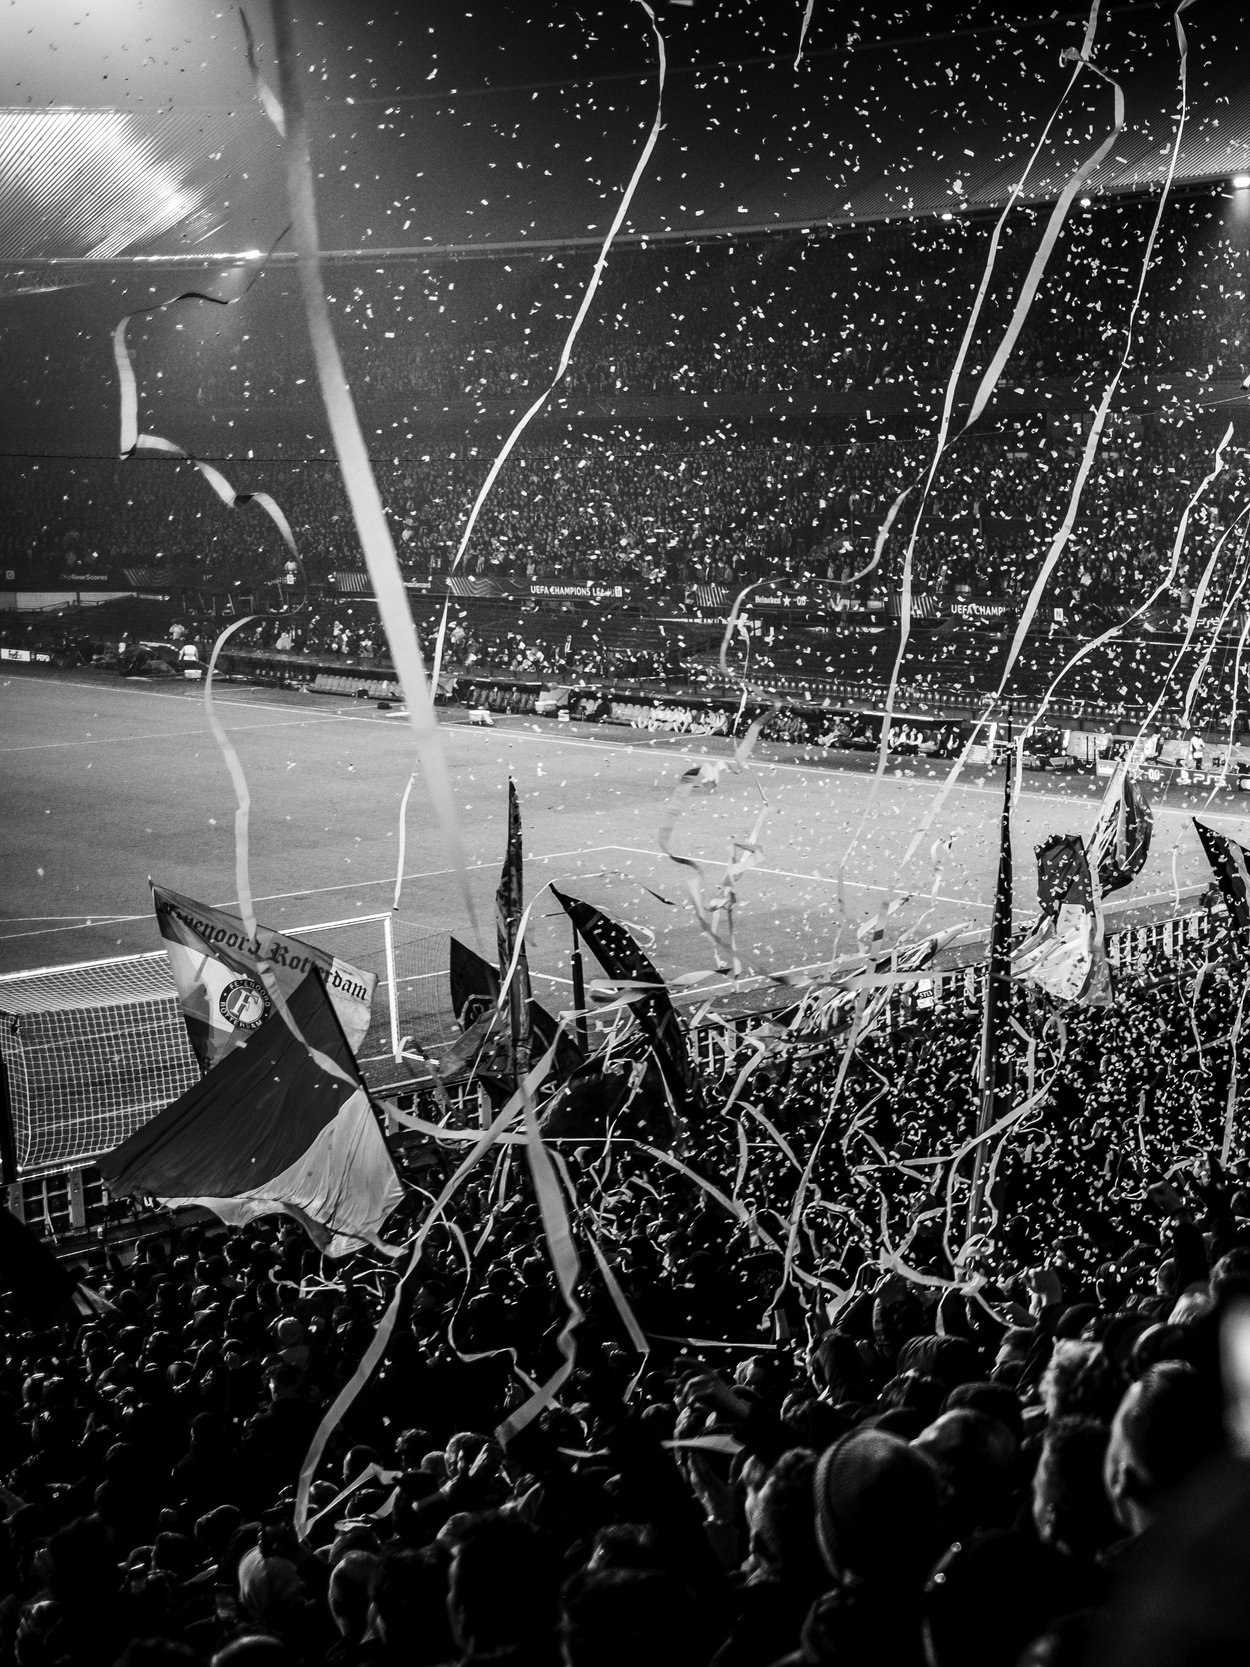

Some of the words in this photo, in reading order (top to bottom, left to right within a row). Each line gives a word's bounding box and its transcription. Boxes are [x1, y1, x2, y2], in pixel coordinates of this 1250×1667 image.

[530, 585, 549, 595] UEFA
[549, 586, 591, 597] CHAMPIONS
[592, 587, 615, 598] LEAU
[950, 604, 973, 615] UEFA
[973, 605, 1006, 616] CHAMPI
[1193, 772, 1226, 787] PS5
